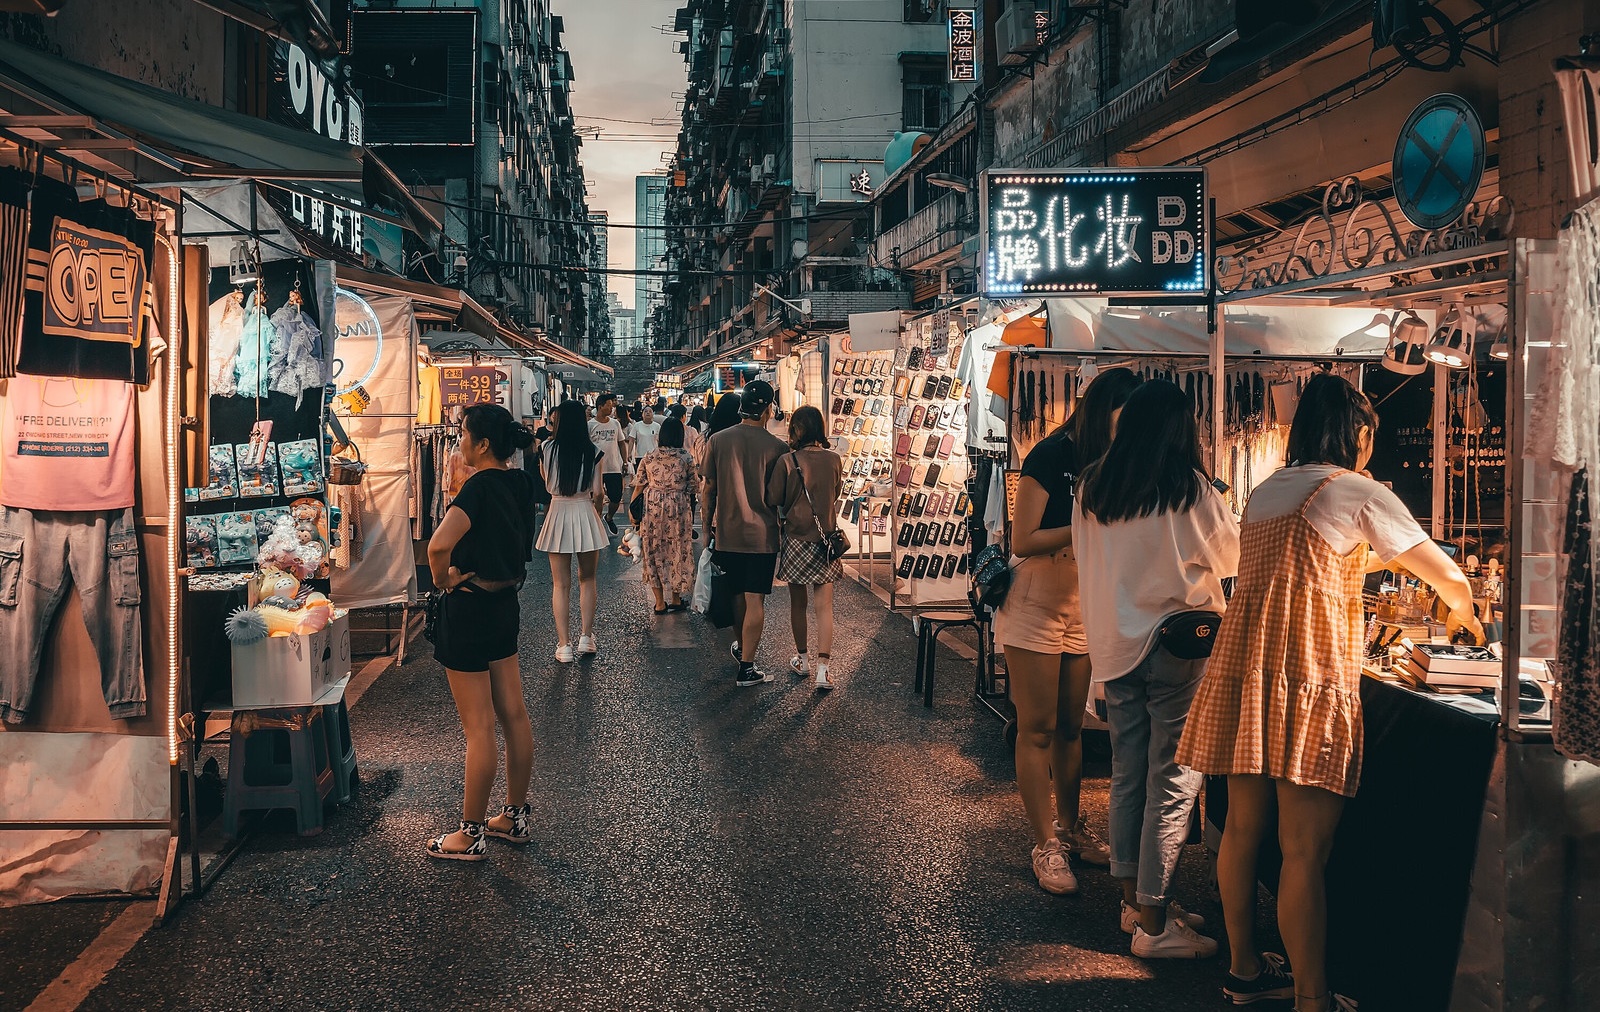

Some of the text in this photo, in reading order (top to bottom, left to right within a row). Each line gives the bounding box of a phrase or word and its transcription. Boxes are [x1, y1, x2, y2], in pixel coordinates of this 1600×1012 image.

[952, 12, 974, 79] 金波酒店
[445, 370, 461, 378] 全场
